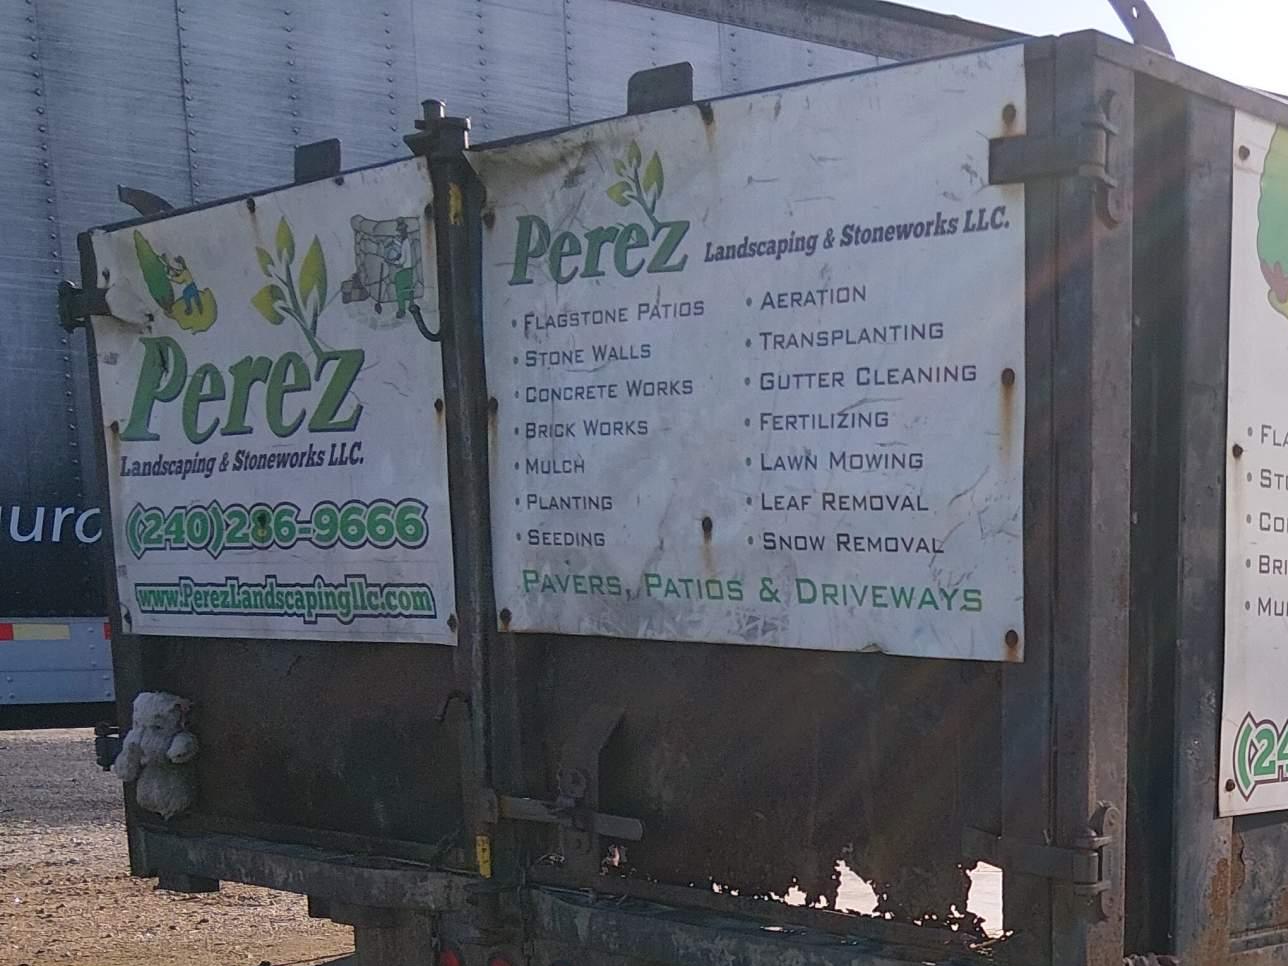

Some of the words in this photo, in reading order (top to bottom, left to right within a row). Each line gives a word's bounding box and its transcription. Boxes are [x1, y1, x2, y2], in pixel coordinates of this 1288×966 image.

[704, 236, 818, 262] Landscaping
[823, 228, 835, 248] &
[840, 211, 958, 247] Stoneworks
[962, 206, 1010, 233] LLC.
[507, 214, 691, 286] Perez
[760, 285, 867, 310] AERATION
[523, 307, 629, 333] FLAGSTONE
[637, 300, 705, 321] PATIOS
[759, 322, 944, 350] TRANSPLANTING
[525, 349, 585, 367] STONE
[592, 344, 652, 361] WALLS
[119, 336, 366, 444] Perez
[760, 371, 845, 391] GUTTER
[856, 365, 977, 386] CLEANING
[526, 384, 618, 403] CONCRETE
[626, 379, 694, 397] WORKS
[525, 422, 576, 439] BRICK
[584, 419, 648, 436] WORKS
[760, 411, 889, 431] FERTILIZING
[120, 452, 217, 480] Landscaping
[219, 457, 229, 473] &
[232, 446, 325, 472] Stoneworks
[328, 440, 365, 466] LLC.
[525, 458, 585, 474] MULCH
[760, 454, 818, 471] LAWN
[829, 451, 923, 470] MOWING
[527, 493, 613, 510] PLANTING
[761, 493, 812, 511] LEAF
[822, 493, 928, 512] REMOVAL
[126, 499, 429, 560] (240)286-9666
[528, 529, 605, 547] SEEDING
[763, 532, 825, 551] SNOW
[836, 533, 945, 554] REMOVAL
[134, 574, 437, 625] www.PerezLandscapingllc.com
[523, 569, 631, 601] PAVERS,
[644, 572, 744, 601] PATIOS
[759, 577, 781, 602] &
[794, 578, 983, 613] DRIVEWAYS
